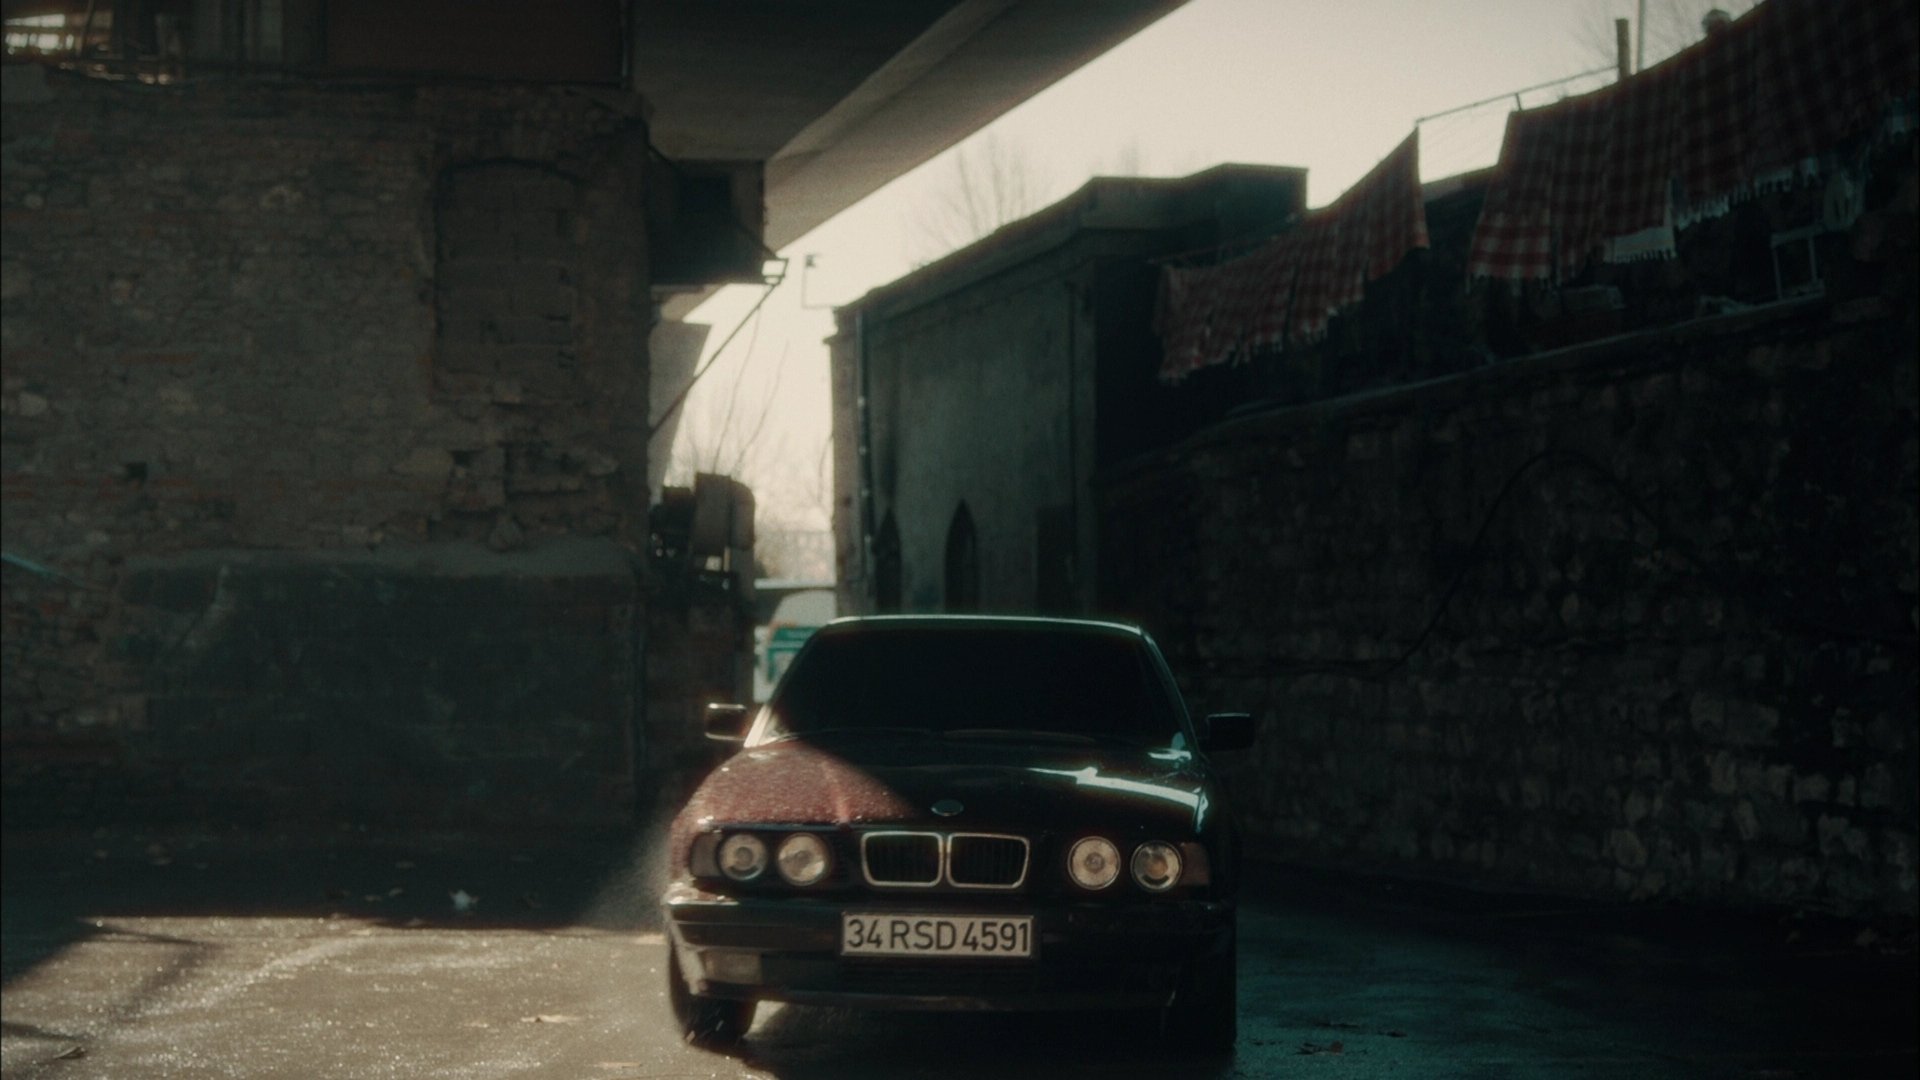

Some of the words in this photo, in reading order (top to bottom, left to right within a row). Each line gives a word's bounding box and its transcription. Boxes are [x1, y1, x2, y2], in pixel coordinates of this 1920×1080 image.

[847, 919, 882, 948] 34
[890, 920, 956, 950] RSD
[962, 921, 1028, 952] 4591
